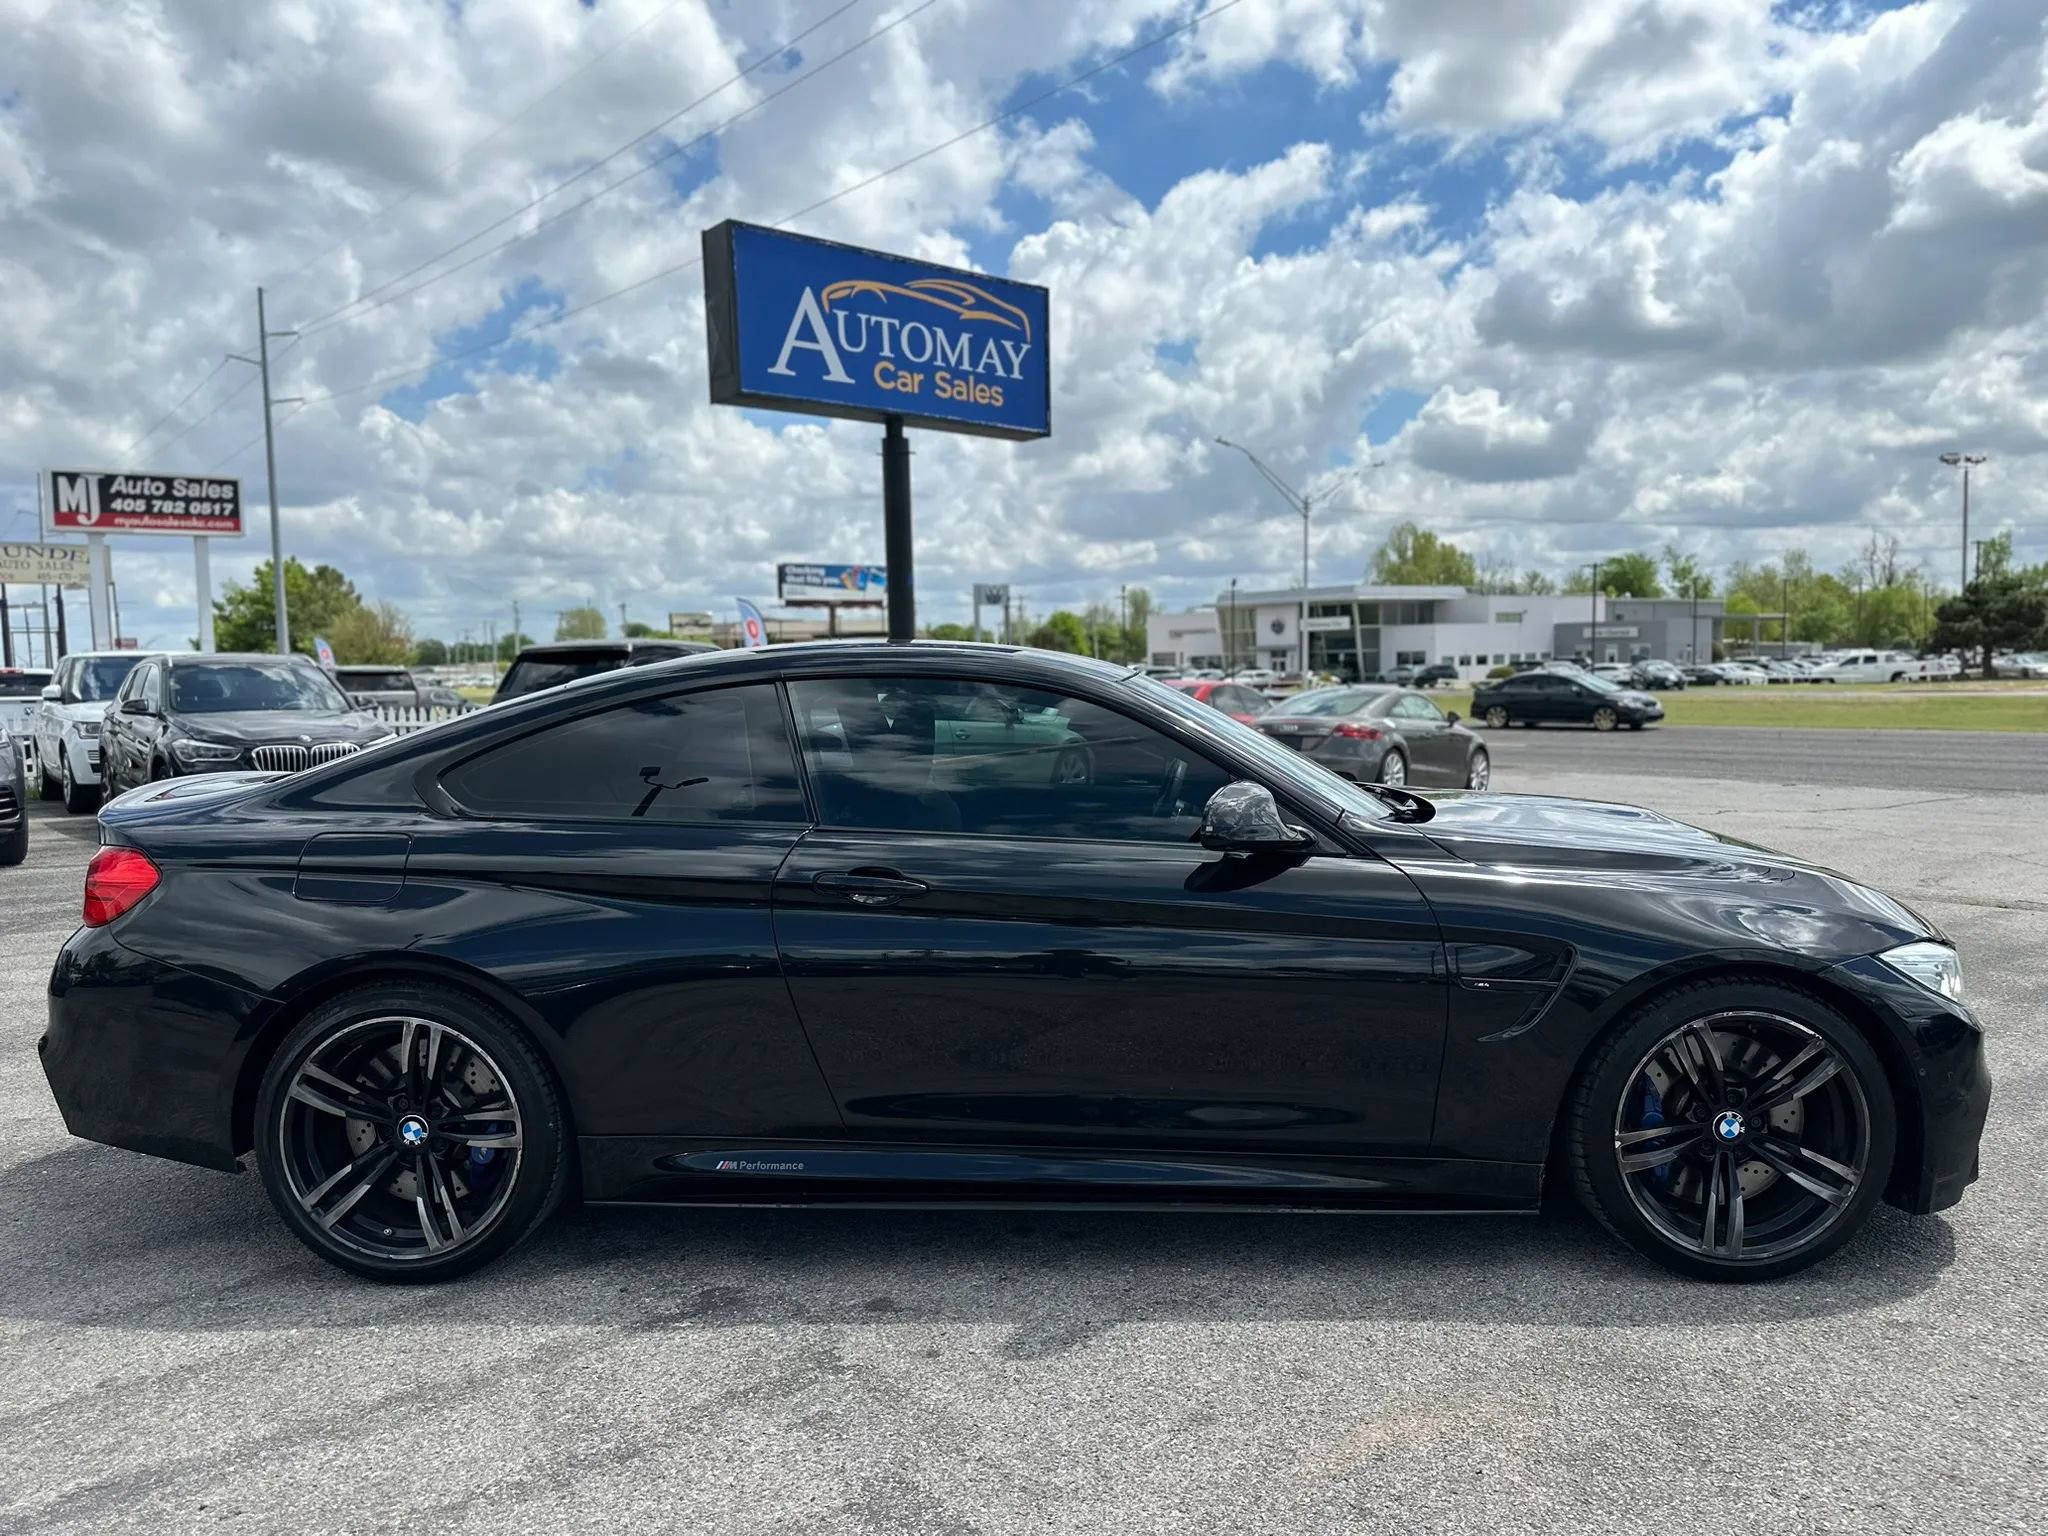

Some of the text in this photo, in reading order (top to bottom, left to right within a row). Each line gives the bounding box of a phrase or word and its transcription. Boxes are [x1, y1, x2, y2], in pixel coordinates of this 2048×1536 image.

[768, 286, 1032, 384] AUTOMAY
[873, 361, 1004, 407] Car Sales
[110, 475, 234, 499] Auto Sales
[56, 473, 105, 526] MJ
[110, 499, 234, 516] 405 782 0517
[37, 561, 75, 570] SALES
[740, 1161, 804, 1170] Performance
